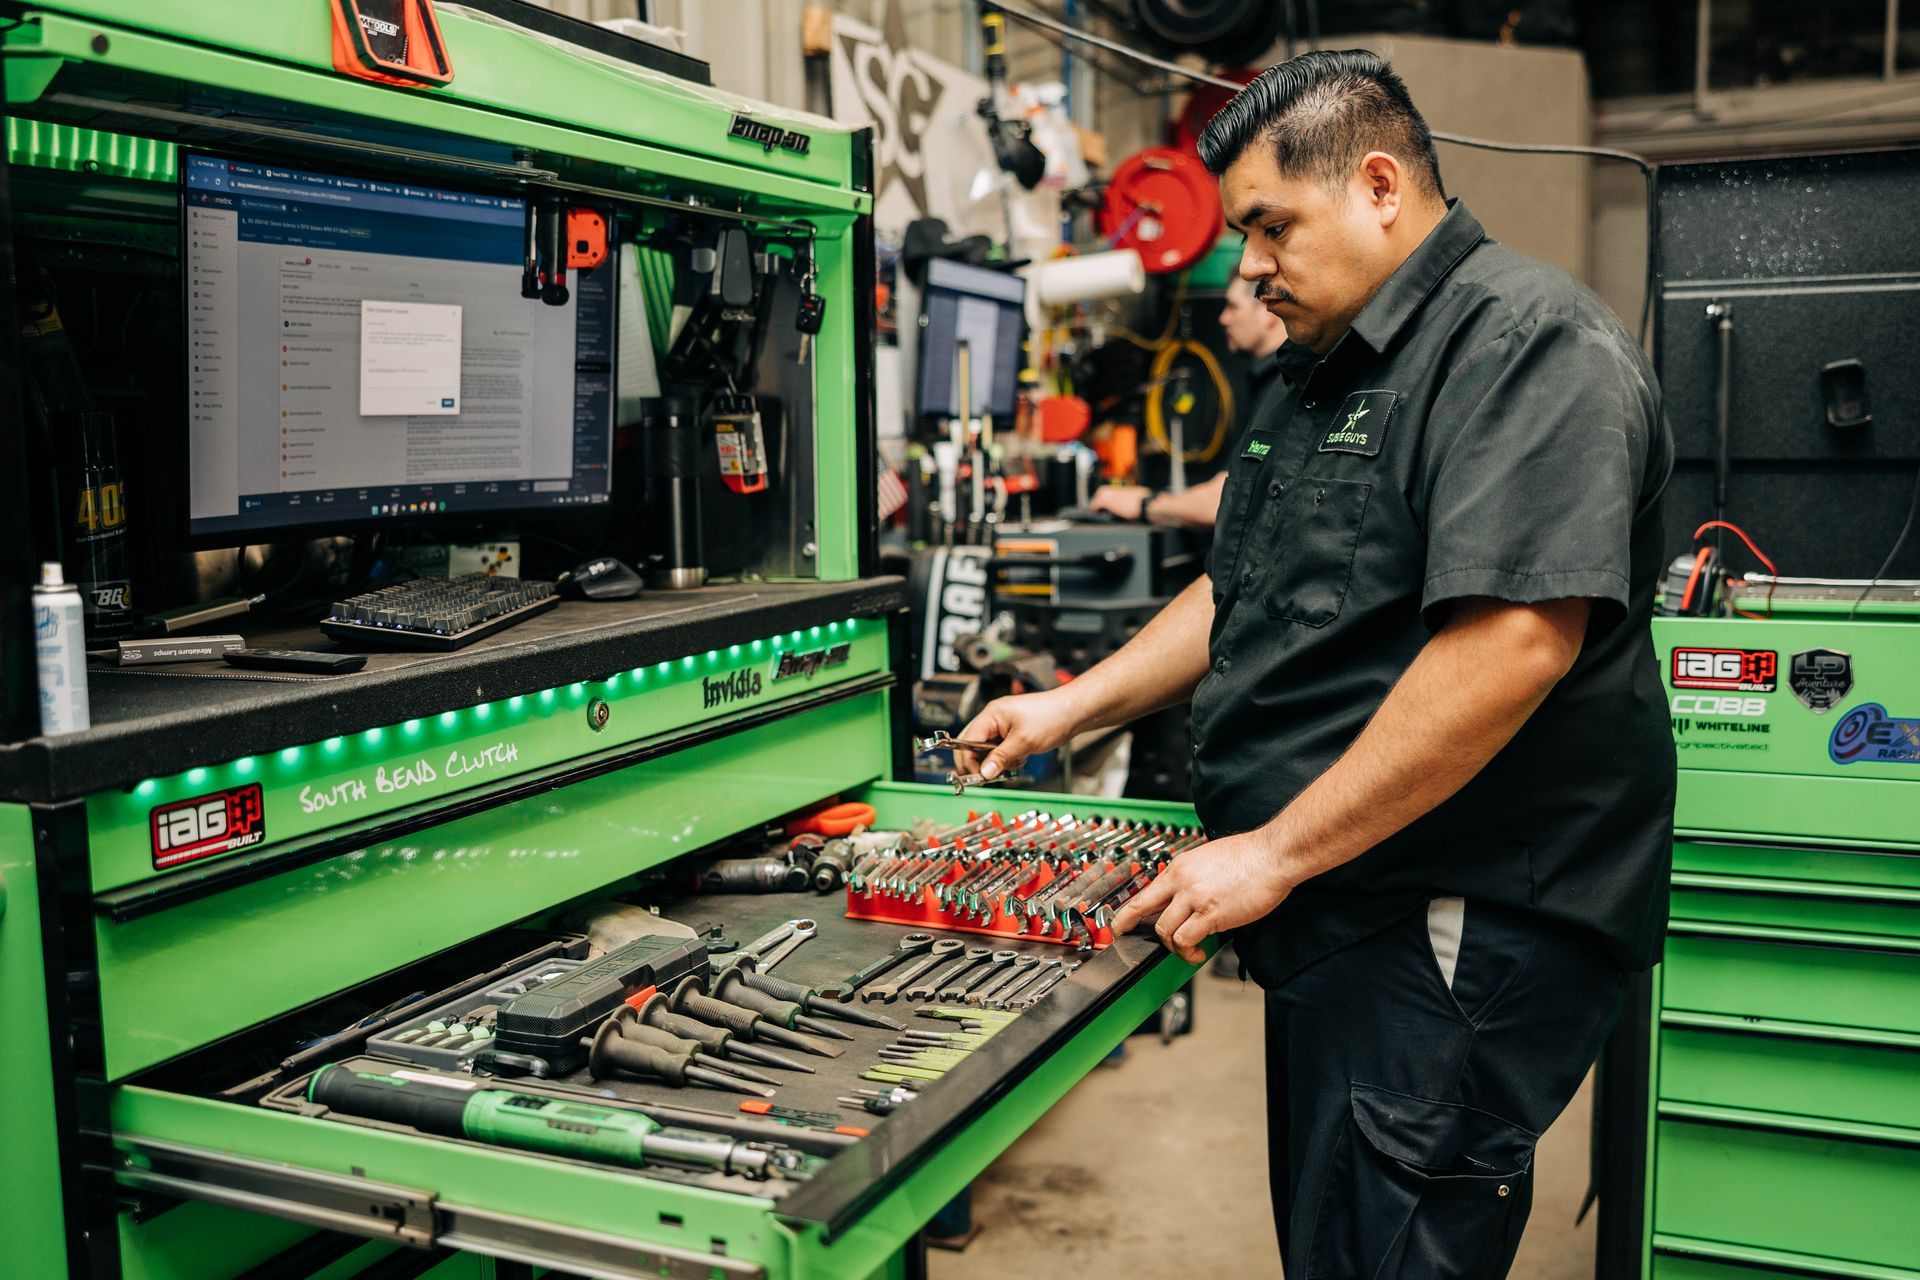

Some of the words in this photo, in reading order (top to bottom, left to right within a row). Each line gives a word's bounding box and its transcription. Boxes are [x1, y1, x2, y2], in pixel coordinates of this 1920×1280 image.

[1344, 431, 1368, 445] GUYS
[91, 588, 127, 609] BG
[153, 649, 177, 657] Lamps
[178, 647, 212, 656] Miniature
[1794, 653, 1846, 679] LP
[1738, 683, 1775, 692] BUILT
[1671, 695, 1767, 716] COBB
[1695, 721, 1770, 733] WHITELINE
[299, 779, 367, 813] SOUTH
[375, 758, 437, 793] BEND
[445, 742, 518, 777] CLUTCH
[227, 831, 263, 849] BUILT
